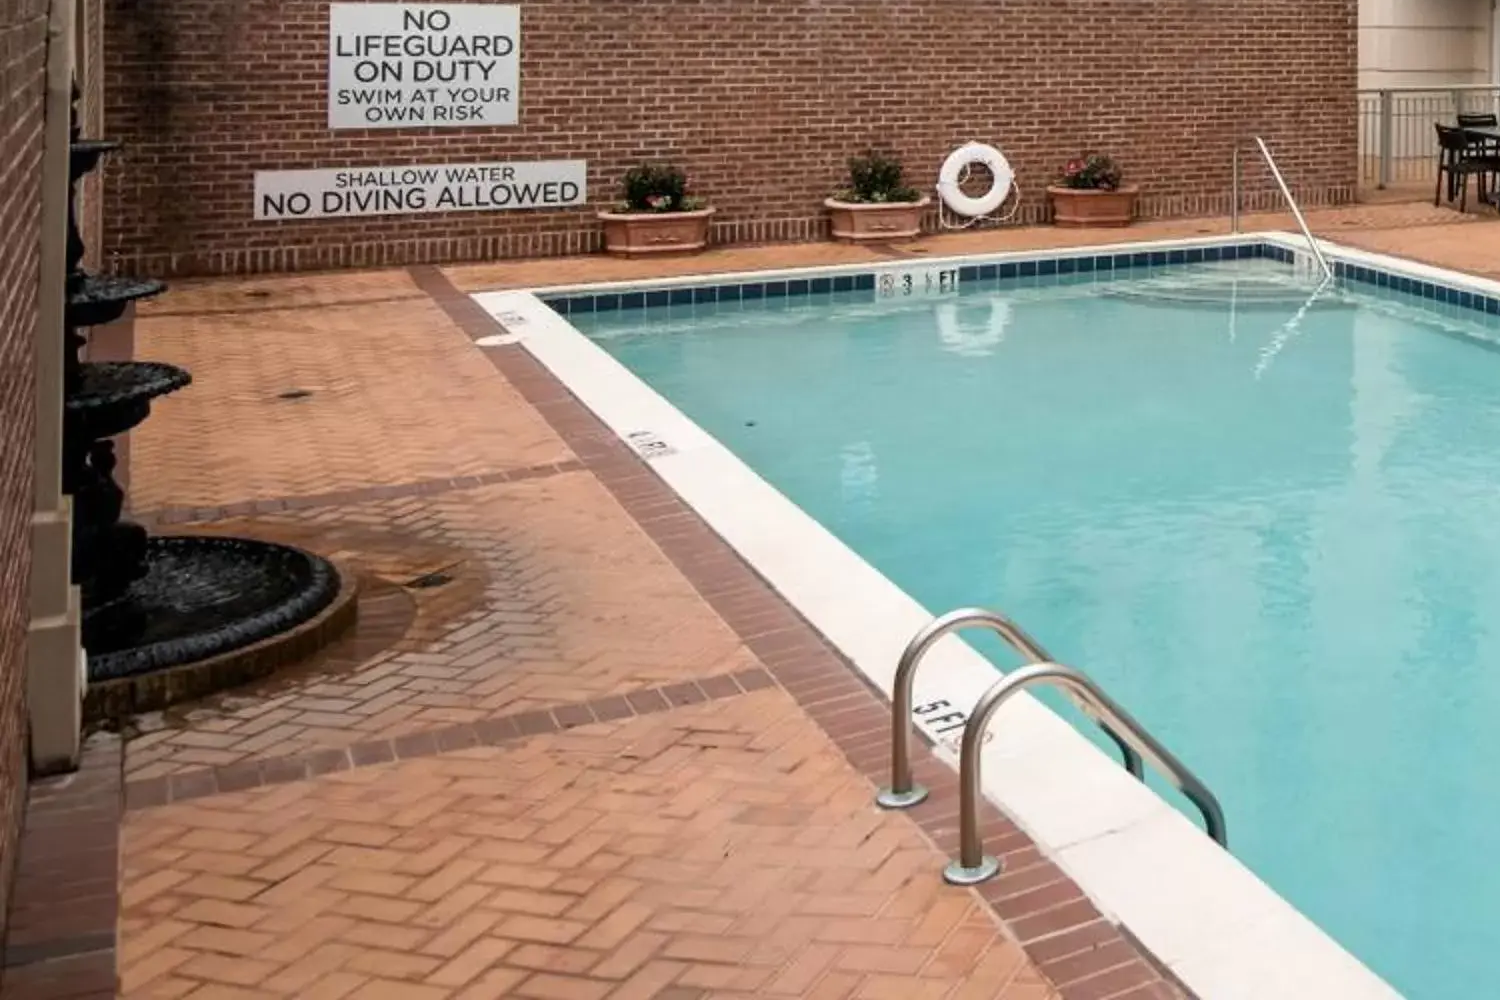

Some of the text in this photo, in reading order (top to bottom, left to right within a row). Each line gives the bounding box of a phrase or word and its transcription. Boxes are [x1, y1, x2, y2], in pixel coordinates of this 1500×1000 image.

[403, 10, 451, 31] NO
[336, 34, 514, 57] LIFEGUARD
[354, 60, 497, 83] ON DUTY
[337, 87, 511, 105] SWIM AT YOUR
[365, 105, 484, 123] OWN RISK
[335, 166, 516, 188] SHALLOW WATER
[263, 180, 580, 216] NO DIVING ALLOWED
[902, 273, 913, 287] 3
[939, 269, 957, 283] FT
[912, 700, 951, 715] 5
